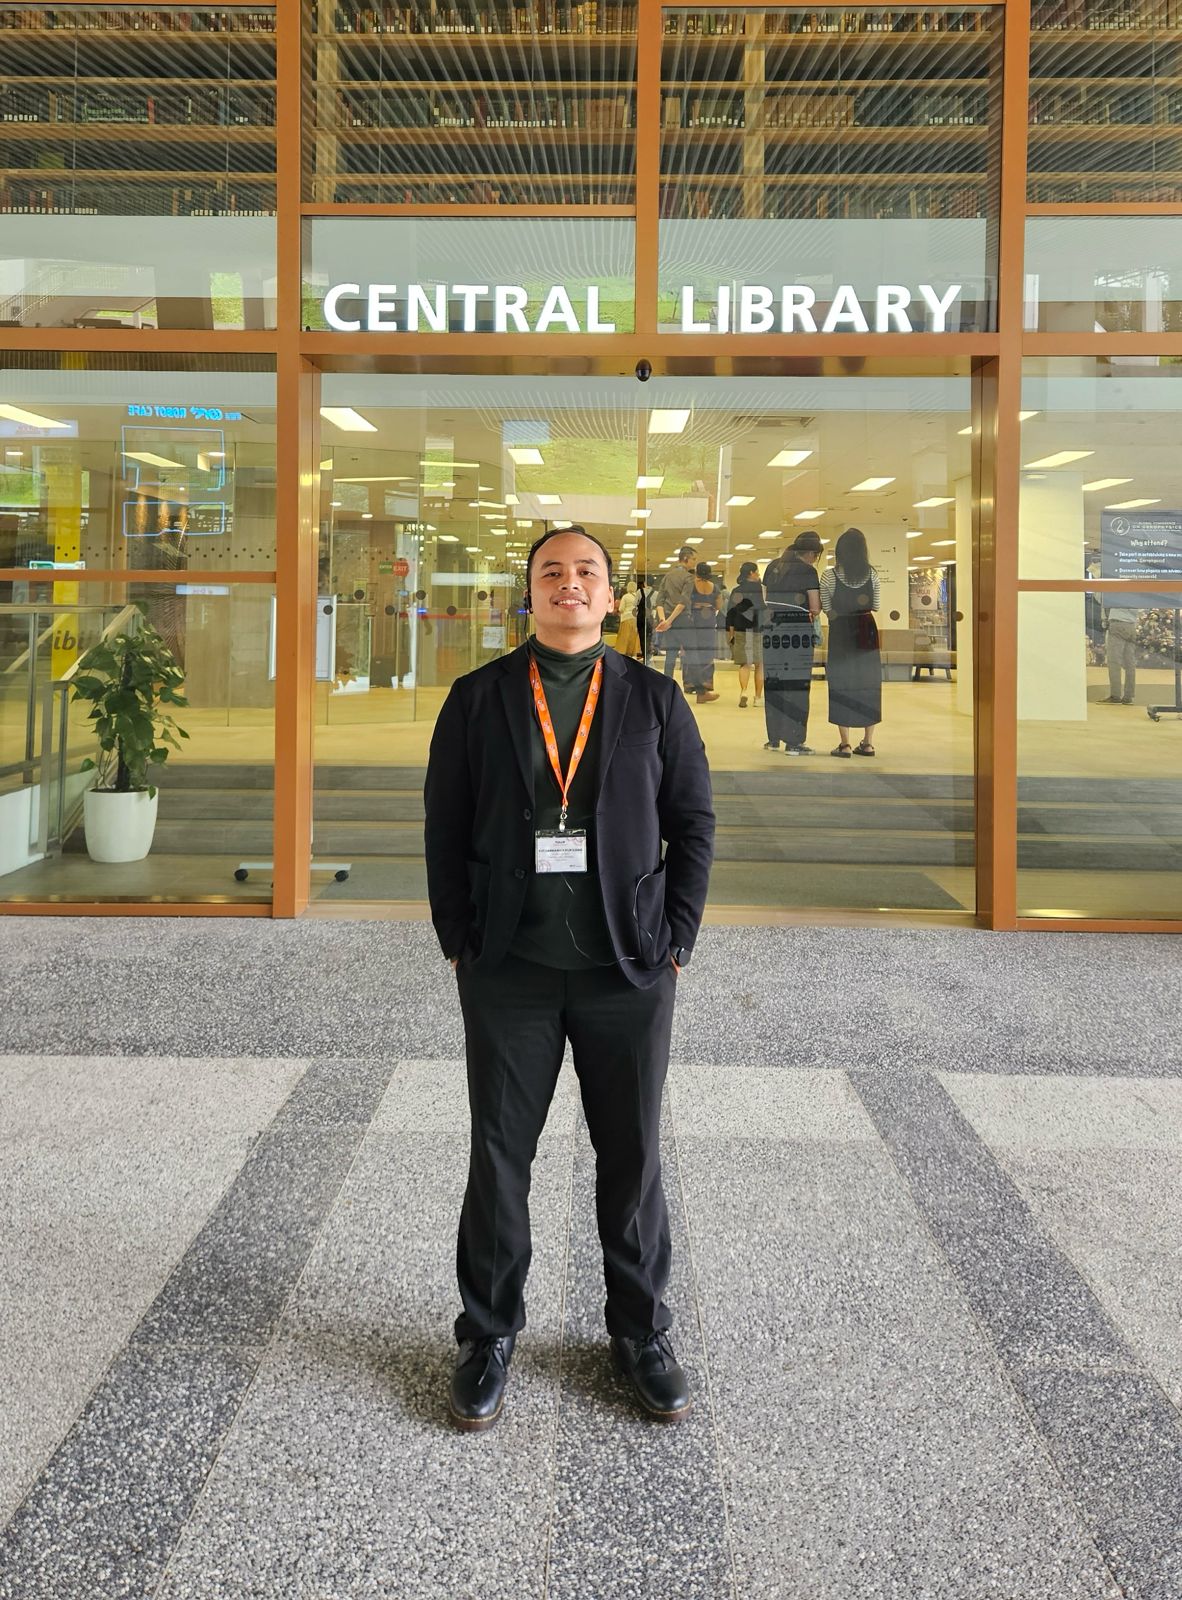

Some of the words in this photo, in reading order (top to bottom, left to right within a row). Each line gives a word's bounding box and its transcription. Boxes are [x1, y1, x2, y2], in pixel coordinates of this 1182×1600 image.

[322, 283, 616, 333] CENTRAL
[681, 284, 963, 333] LIBRARY
[1130, 539, 1143, 547] Why
